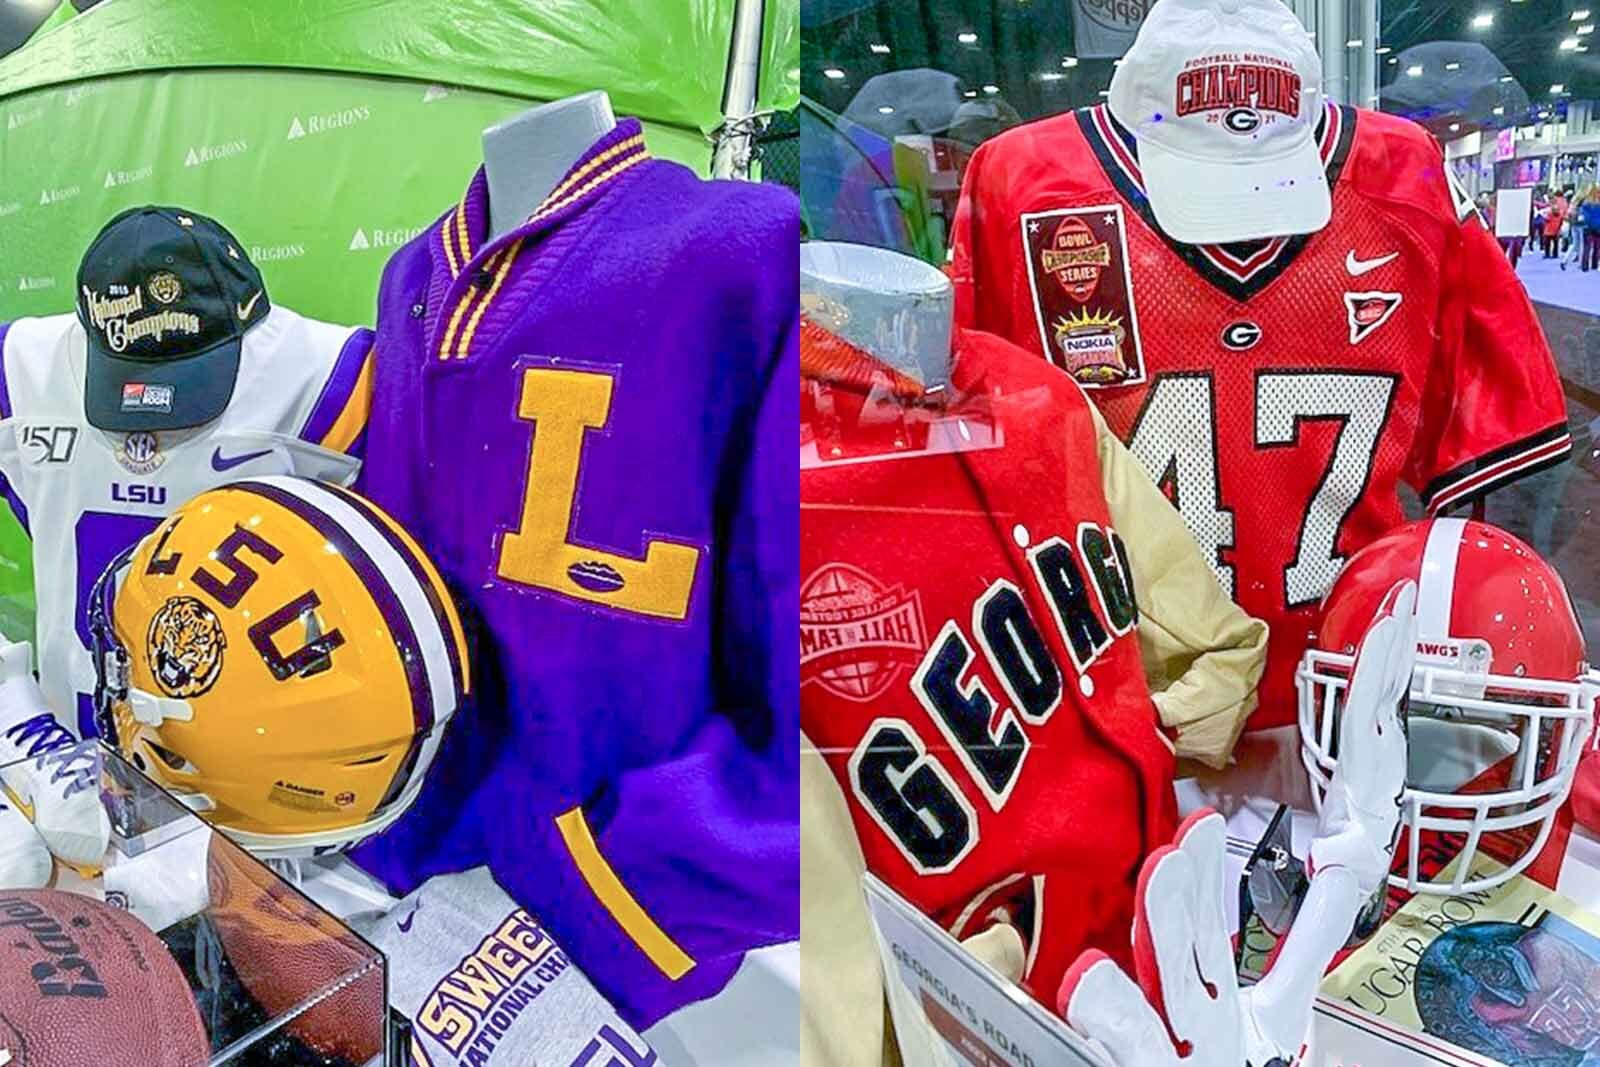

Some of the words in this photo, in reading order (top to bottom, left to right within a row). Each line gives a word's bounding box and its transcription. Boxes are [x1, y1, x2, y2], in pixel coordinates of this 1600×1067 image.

[1185, 53, 1240, 69] FOOTBALL
[1244, 54, 1294, 71] NATIONAL
[1176, 64, 1301, 118] CHAMPIONS
[308, 105, 371, 134] REGIONS
[250, 243, 305, 262] REGIONS
[1058, 233, 1092, 248] BOWL
[1061, 266, 1097, 283] SERIES
[1067, 337, 1114, 350] NOKIA
[112, 483, 166, 505] LSU
[497, 367, 700, 620] L
[1127, 367, 1402, 612] 47
[145, 515, 346, 682] LSU
[892, 942, 978, 1025] GEORGIA'S
